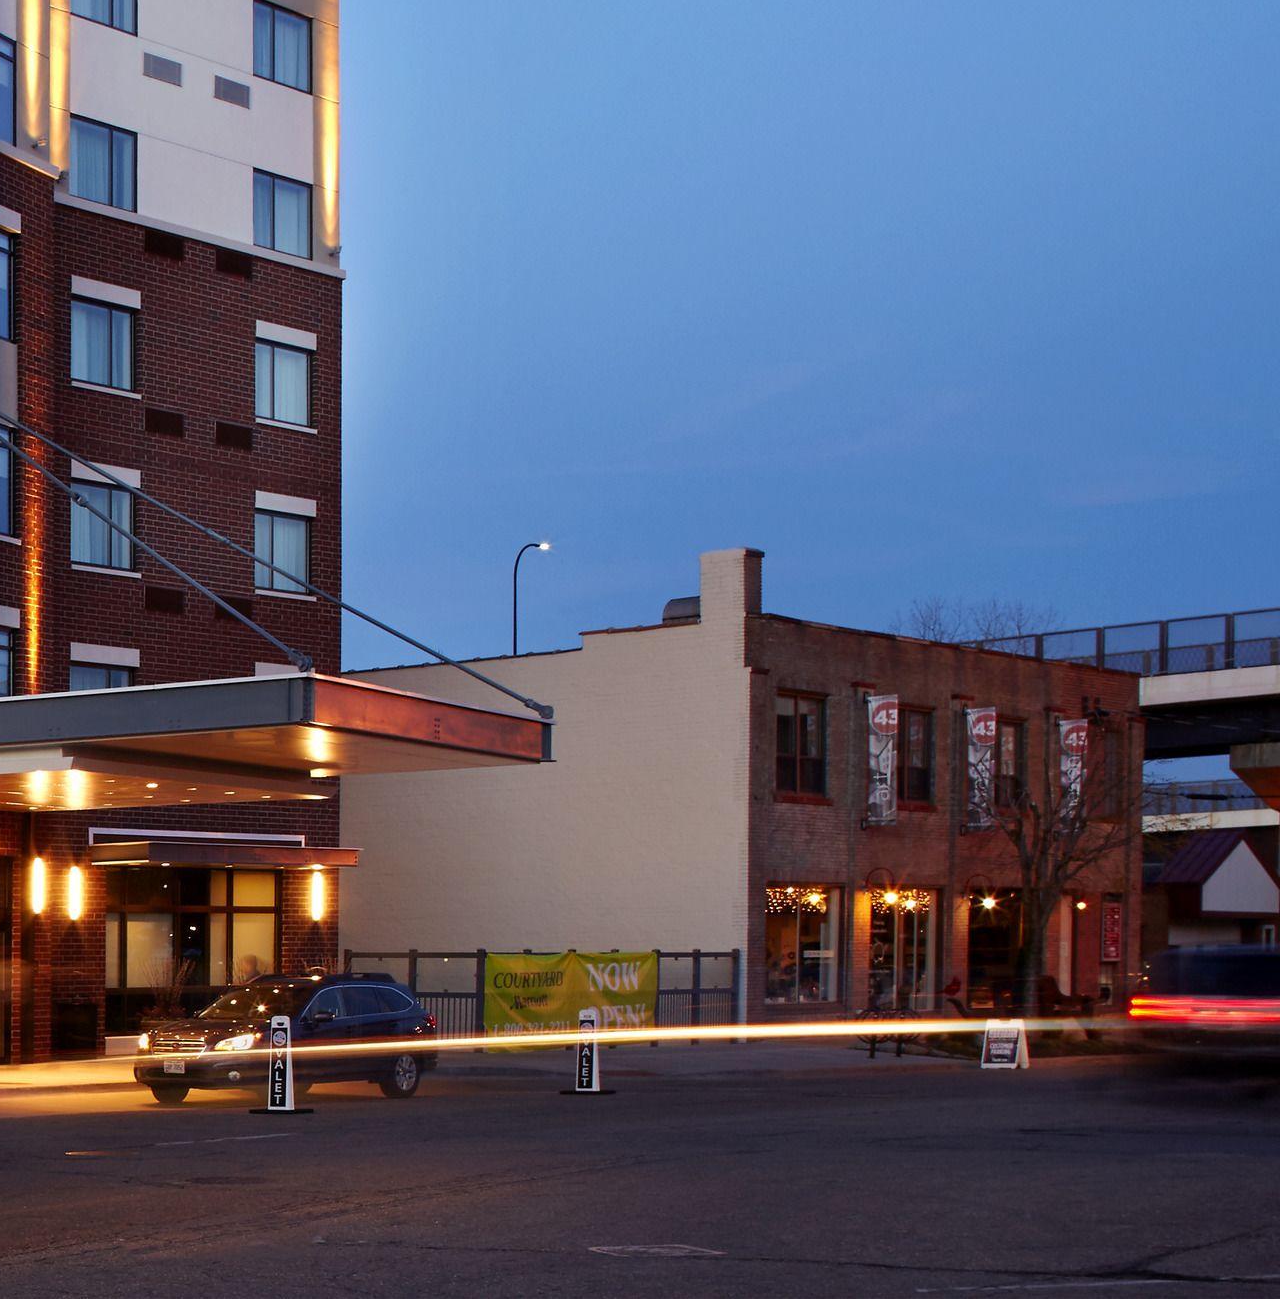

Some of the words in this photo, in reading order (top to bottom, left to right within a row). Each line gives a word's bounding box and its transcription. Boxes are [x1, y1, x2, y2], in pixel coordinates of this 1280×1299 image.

[874, 708, 897, 725] 43
[973, 721, 995, 737] 43
[1067, 731, 1088, 747] 43
[493, 971, 564, 989] COURTYARD
[587, 961, 641, 991] NOW
[273, 1048, 284, 1105] VALET
